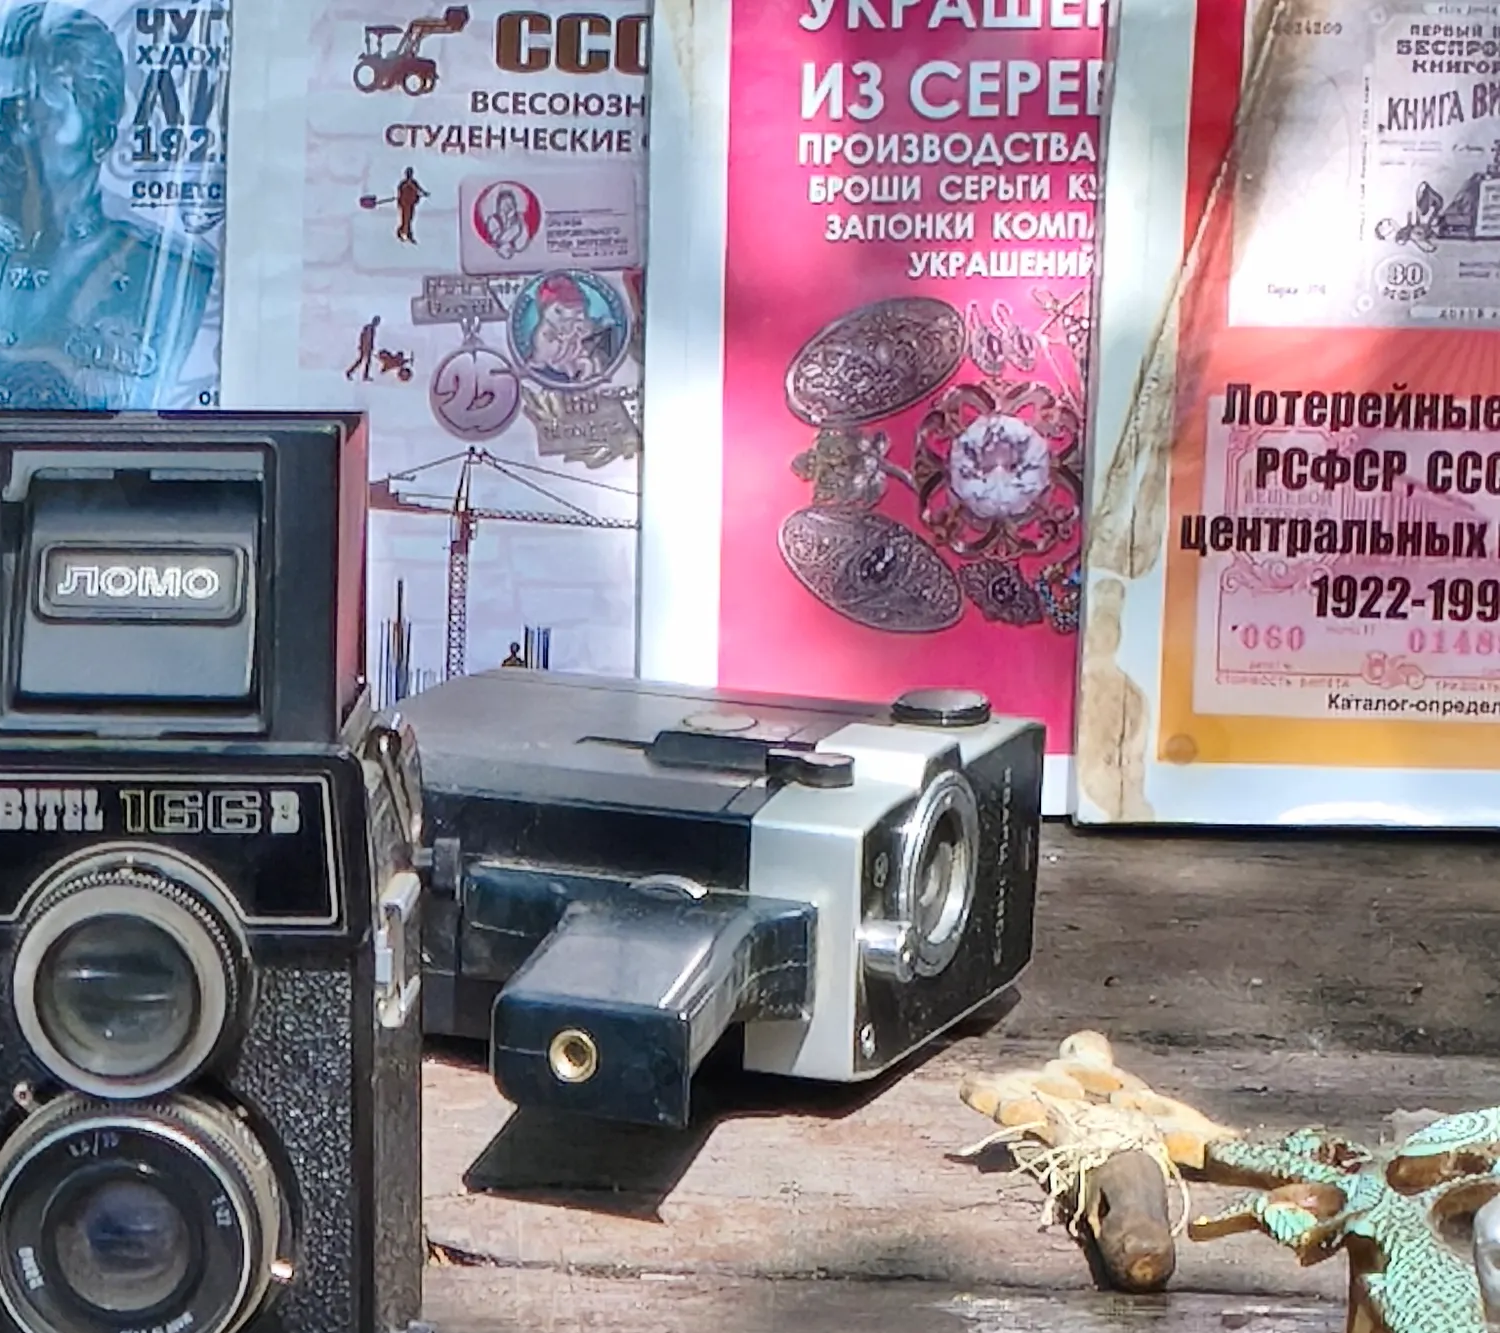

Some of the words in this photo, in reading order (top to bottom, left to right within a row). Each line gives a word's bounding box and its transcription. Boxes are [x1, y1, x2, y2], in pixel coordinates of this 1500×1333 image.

[1397, 40, 1500, 57] БЕСПРО
[470, 91, 646, 117] ВСЕСОЮЗН
[799, 60, 884, 120] ИЗ
[132, 127, 226, 163] 192
[385, 124, 632, 153] СТУДЕНЧЕСКИЕ
[798, 133, 1095, 167] ПРОИЗВОДСТВА
[809, 175, 922, 203] БРОШИ
[939, 175, 1051, 202] СЕРЬГИ
[824, 212, 975, 242] ЗАПОНКИ
[1221, 383, 1500, 432] Лотерейные
[1179, 514, 1489, 558] центральных
[56, 565, 220, 599] ЛОМО
[1408, 628, 1500, 655] 0148
